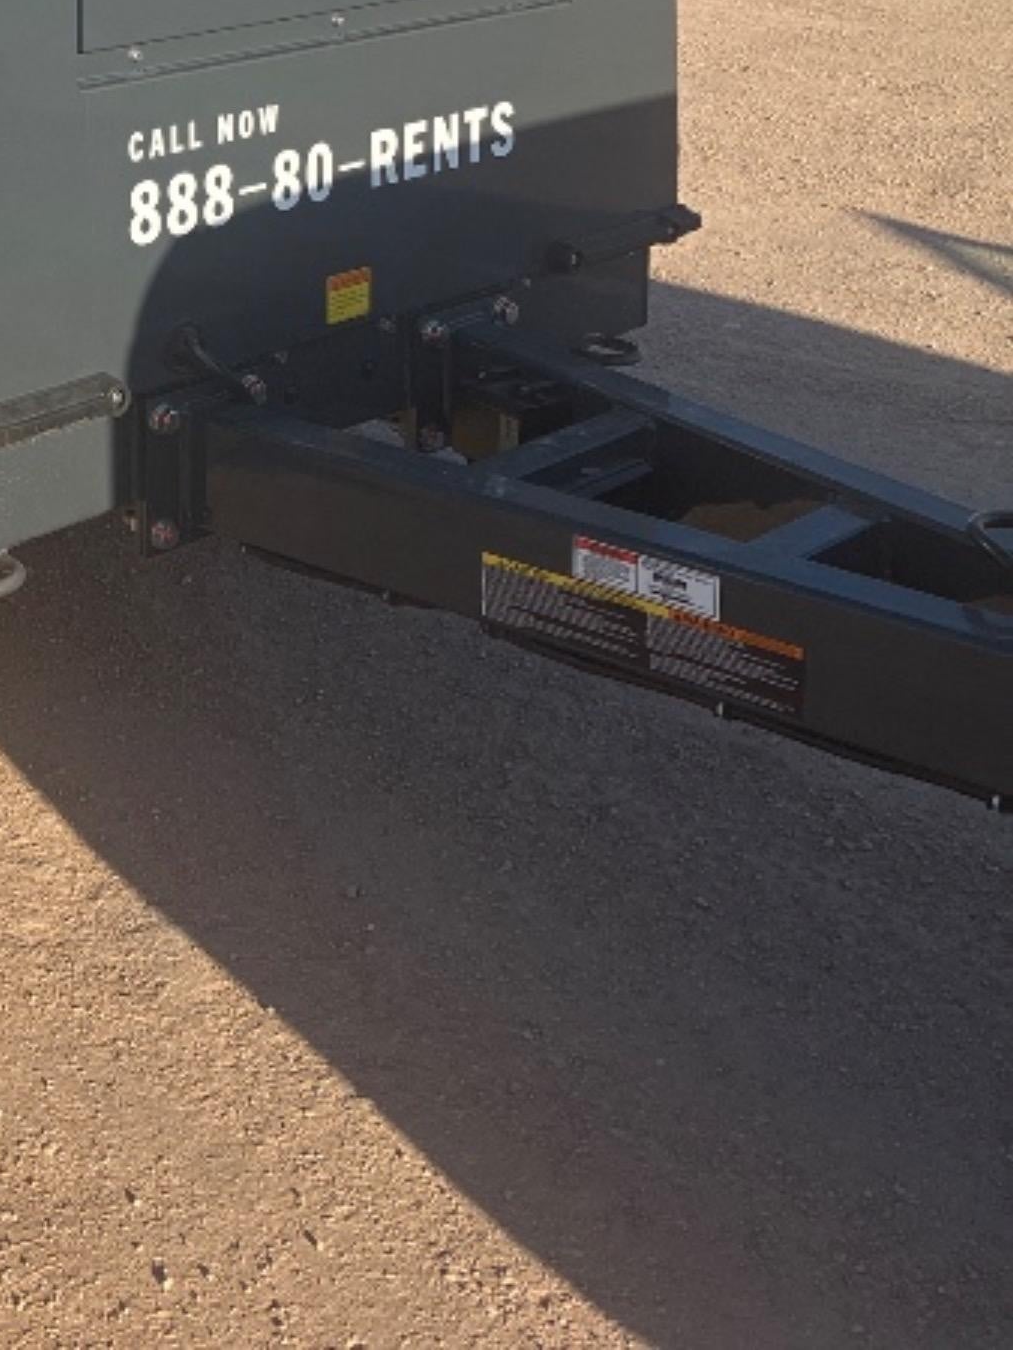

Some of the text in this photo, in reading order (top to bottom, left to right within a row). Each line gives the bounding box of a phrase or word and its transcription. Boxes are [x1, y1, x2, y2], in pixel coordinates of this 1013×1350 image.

[128, 104, 280, 163] CALL NOW
[129, 100, 517, 247] 888-80-RENTS
